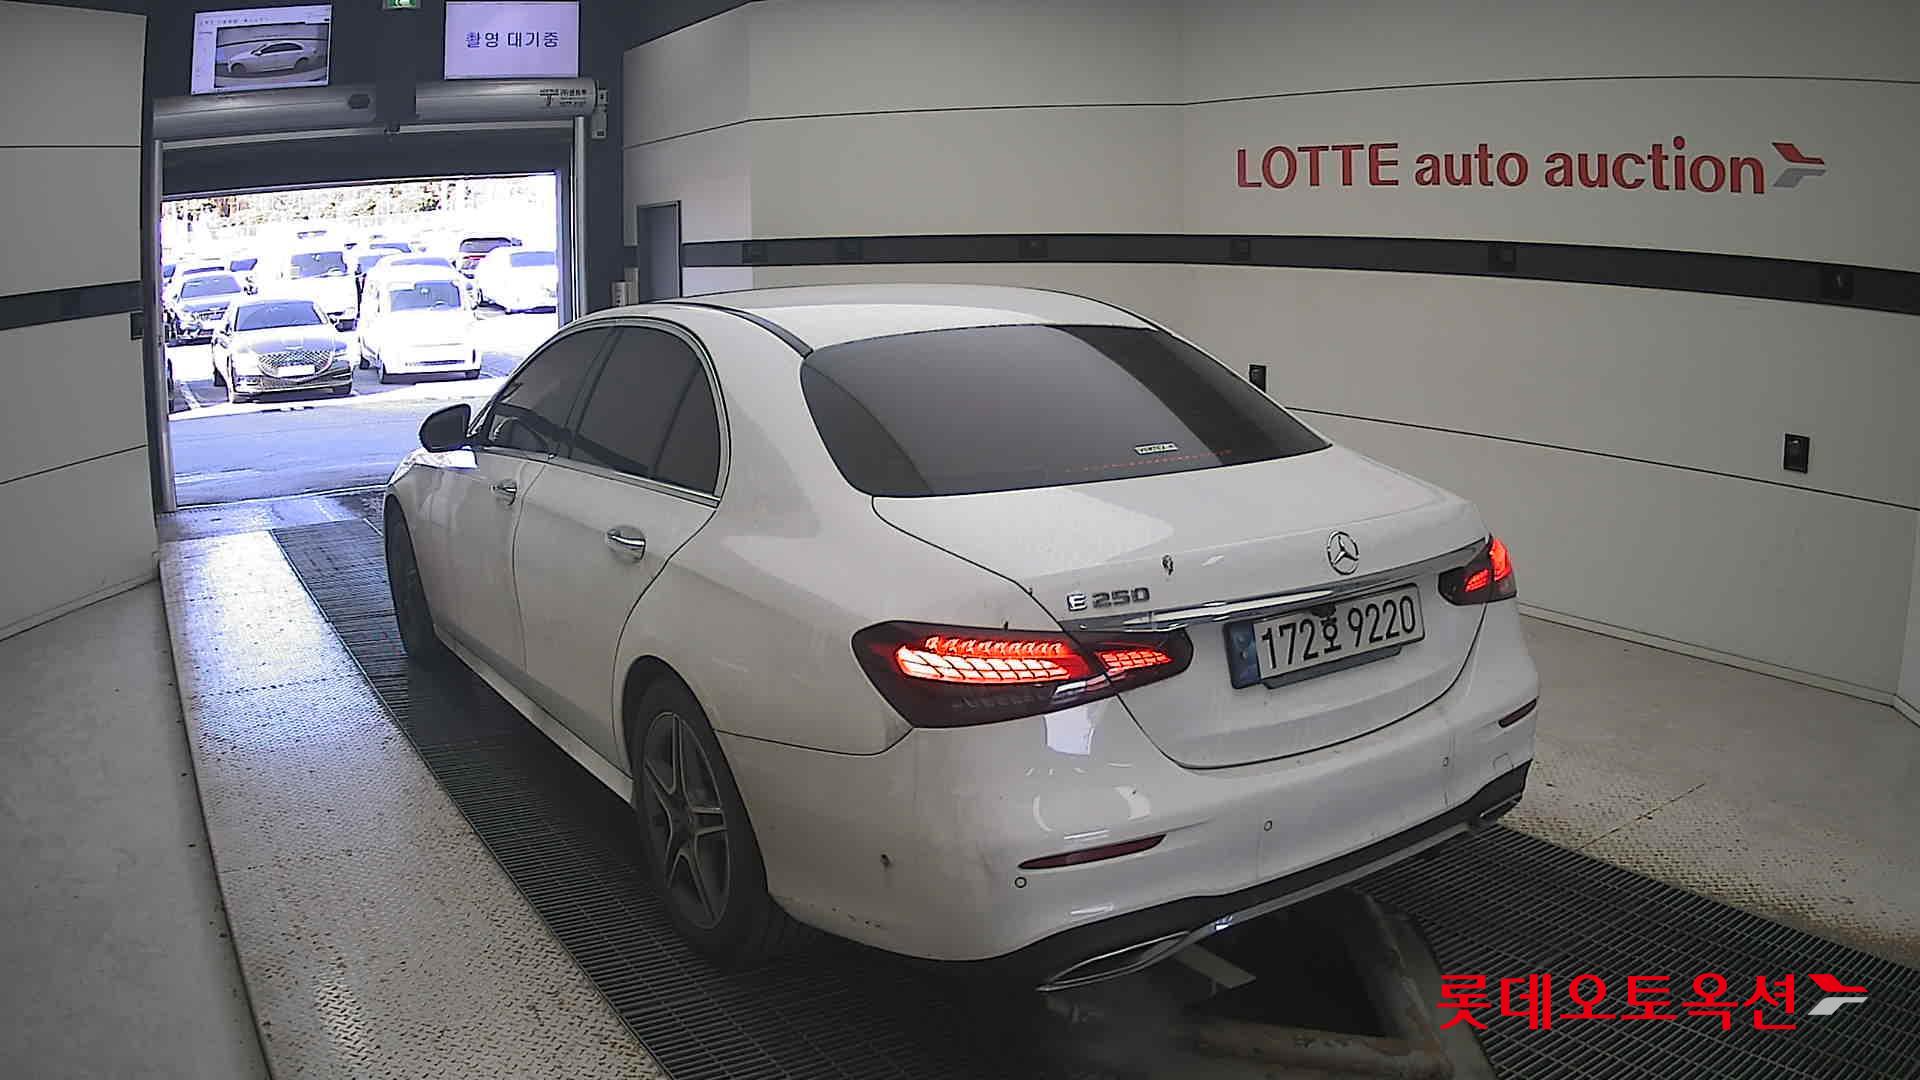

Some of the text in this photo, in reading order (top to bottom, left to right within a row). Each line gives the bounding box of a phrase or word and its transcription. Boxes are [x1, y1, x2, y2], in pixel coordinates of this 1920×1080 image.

[507, 31, 559, 48] 대기중
[1237, 136, 1764, 194] LOTTE auto auction
[1066, 587, 1150, 611] E 250
